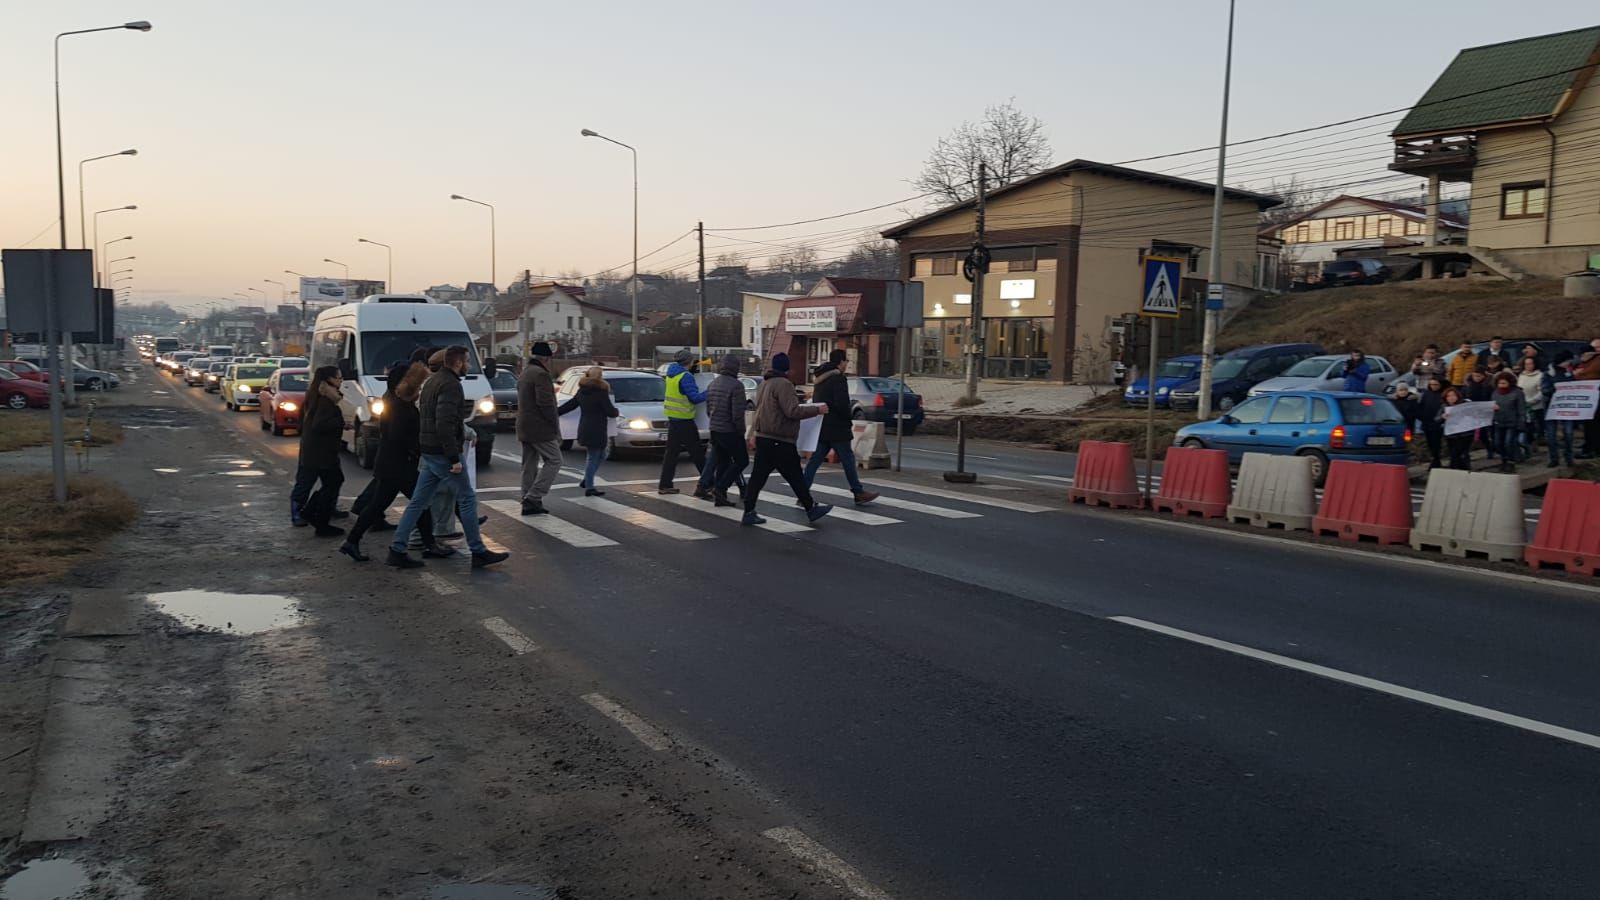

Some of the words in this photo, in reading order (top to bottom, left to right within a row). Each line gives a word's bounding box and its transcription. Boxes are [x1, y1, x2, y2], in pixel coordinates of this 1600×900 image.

[787, 311, 807, 319] MAGAZIN
[809, 310, 815, 319] DE
[816, 310, 832, 319] VINURI
